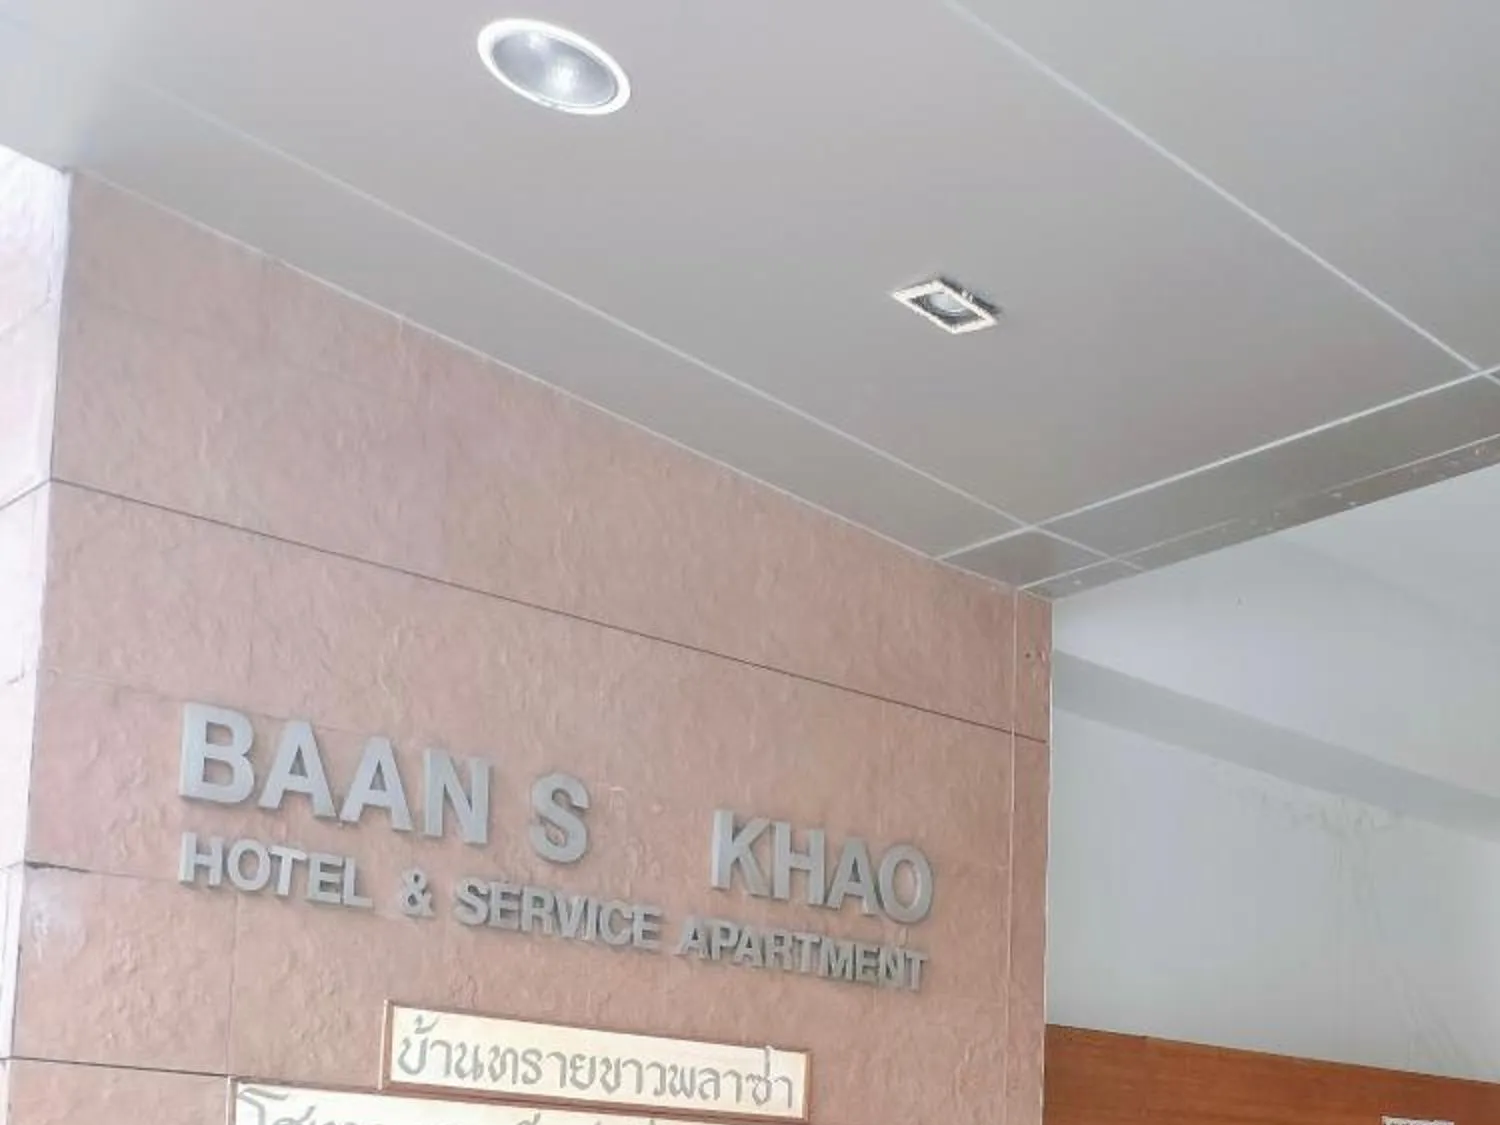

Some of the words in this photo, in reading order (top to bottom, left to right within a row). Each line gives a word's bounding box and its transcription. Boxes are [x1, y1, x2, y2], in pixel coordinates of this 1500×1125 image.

[179, 703, 493, 845] BAAN
[529, 773, 590, 863] S
[711, 809, 934, 924] KHAO
[178, 832, 373, 908] HOTEL
[401, 867, 435, 917] &
[455, 877, 663, 951] SERVICE
[675, 915, 928, 991] APARTMENT
